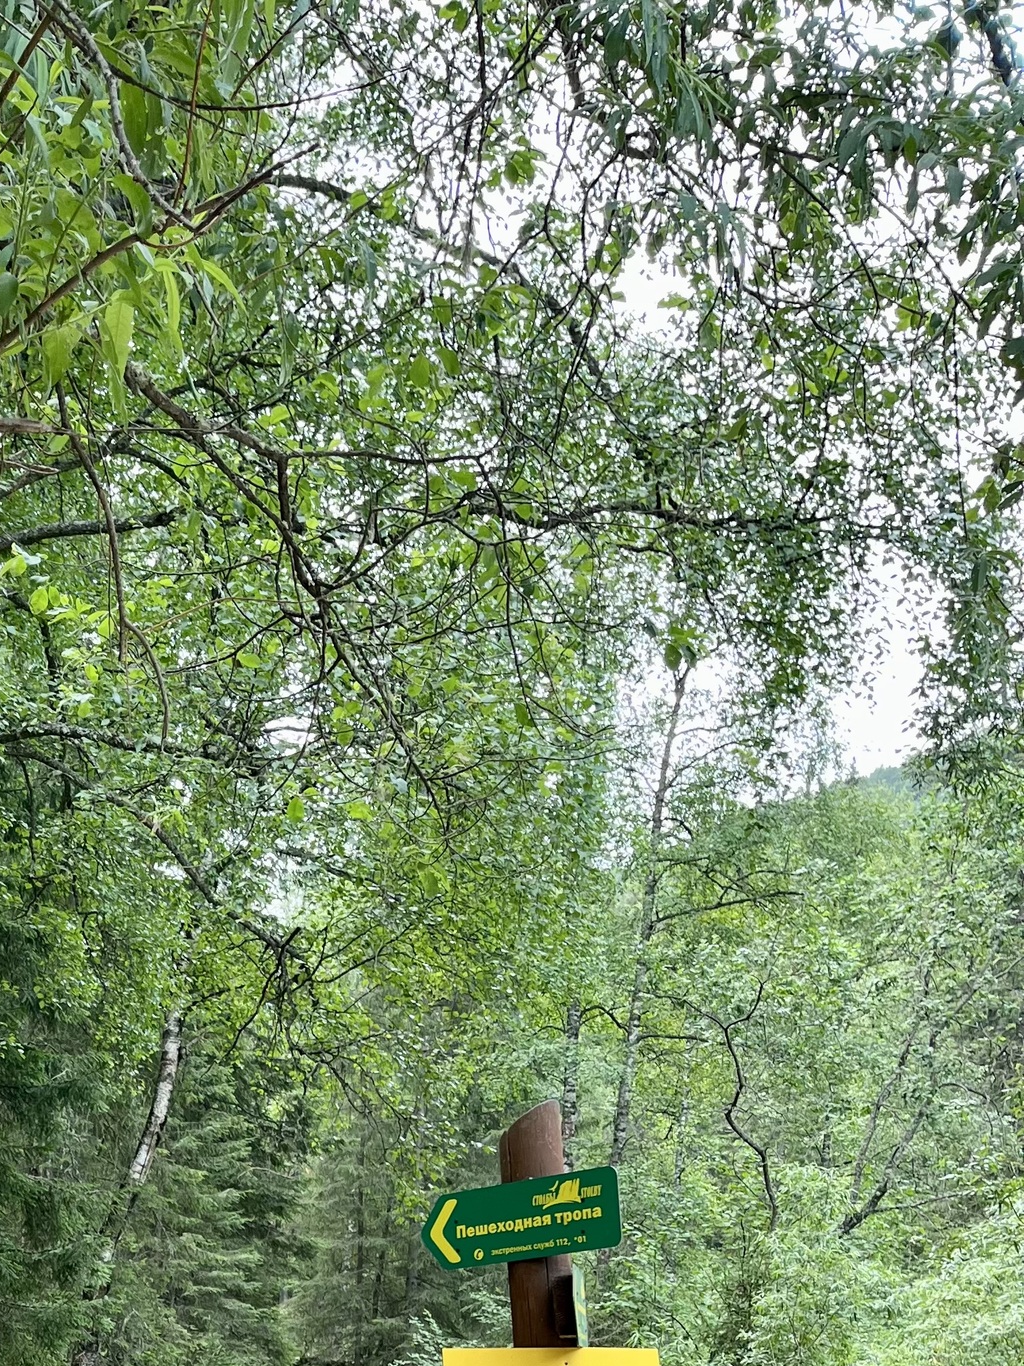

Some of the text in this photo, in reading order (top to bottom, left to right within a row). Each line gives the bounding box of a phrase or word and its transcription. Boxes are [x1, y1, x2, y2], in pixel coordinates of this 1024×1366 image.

[581, 1185, 602, 1198] STOLBY
[456, 1206, 602, 1239] Пешеходная тропа
[491, 1244, 532, 1255] экстренных
[533, 1239, 554, 1250] служб
[556, 1237, 571, 1246] 112,
